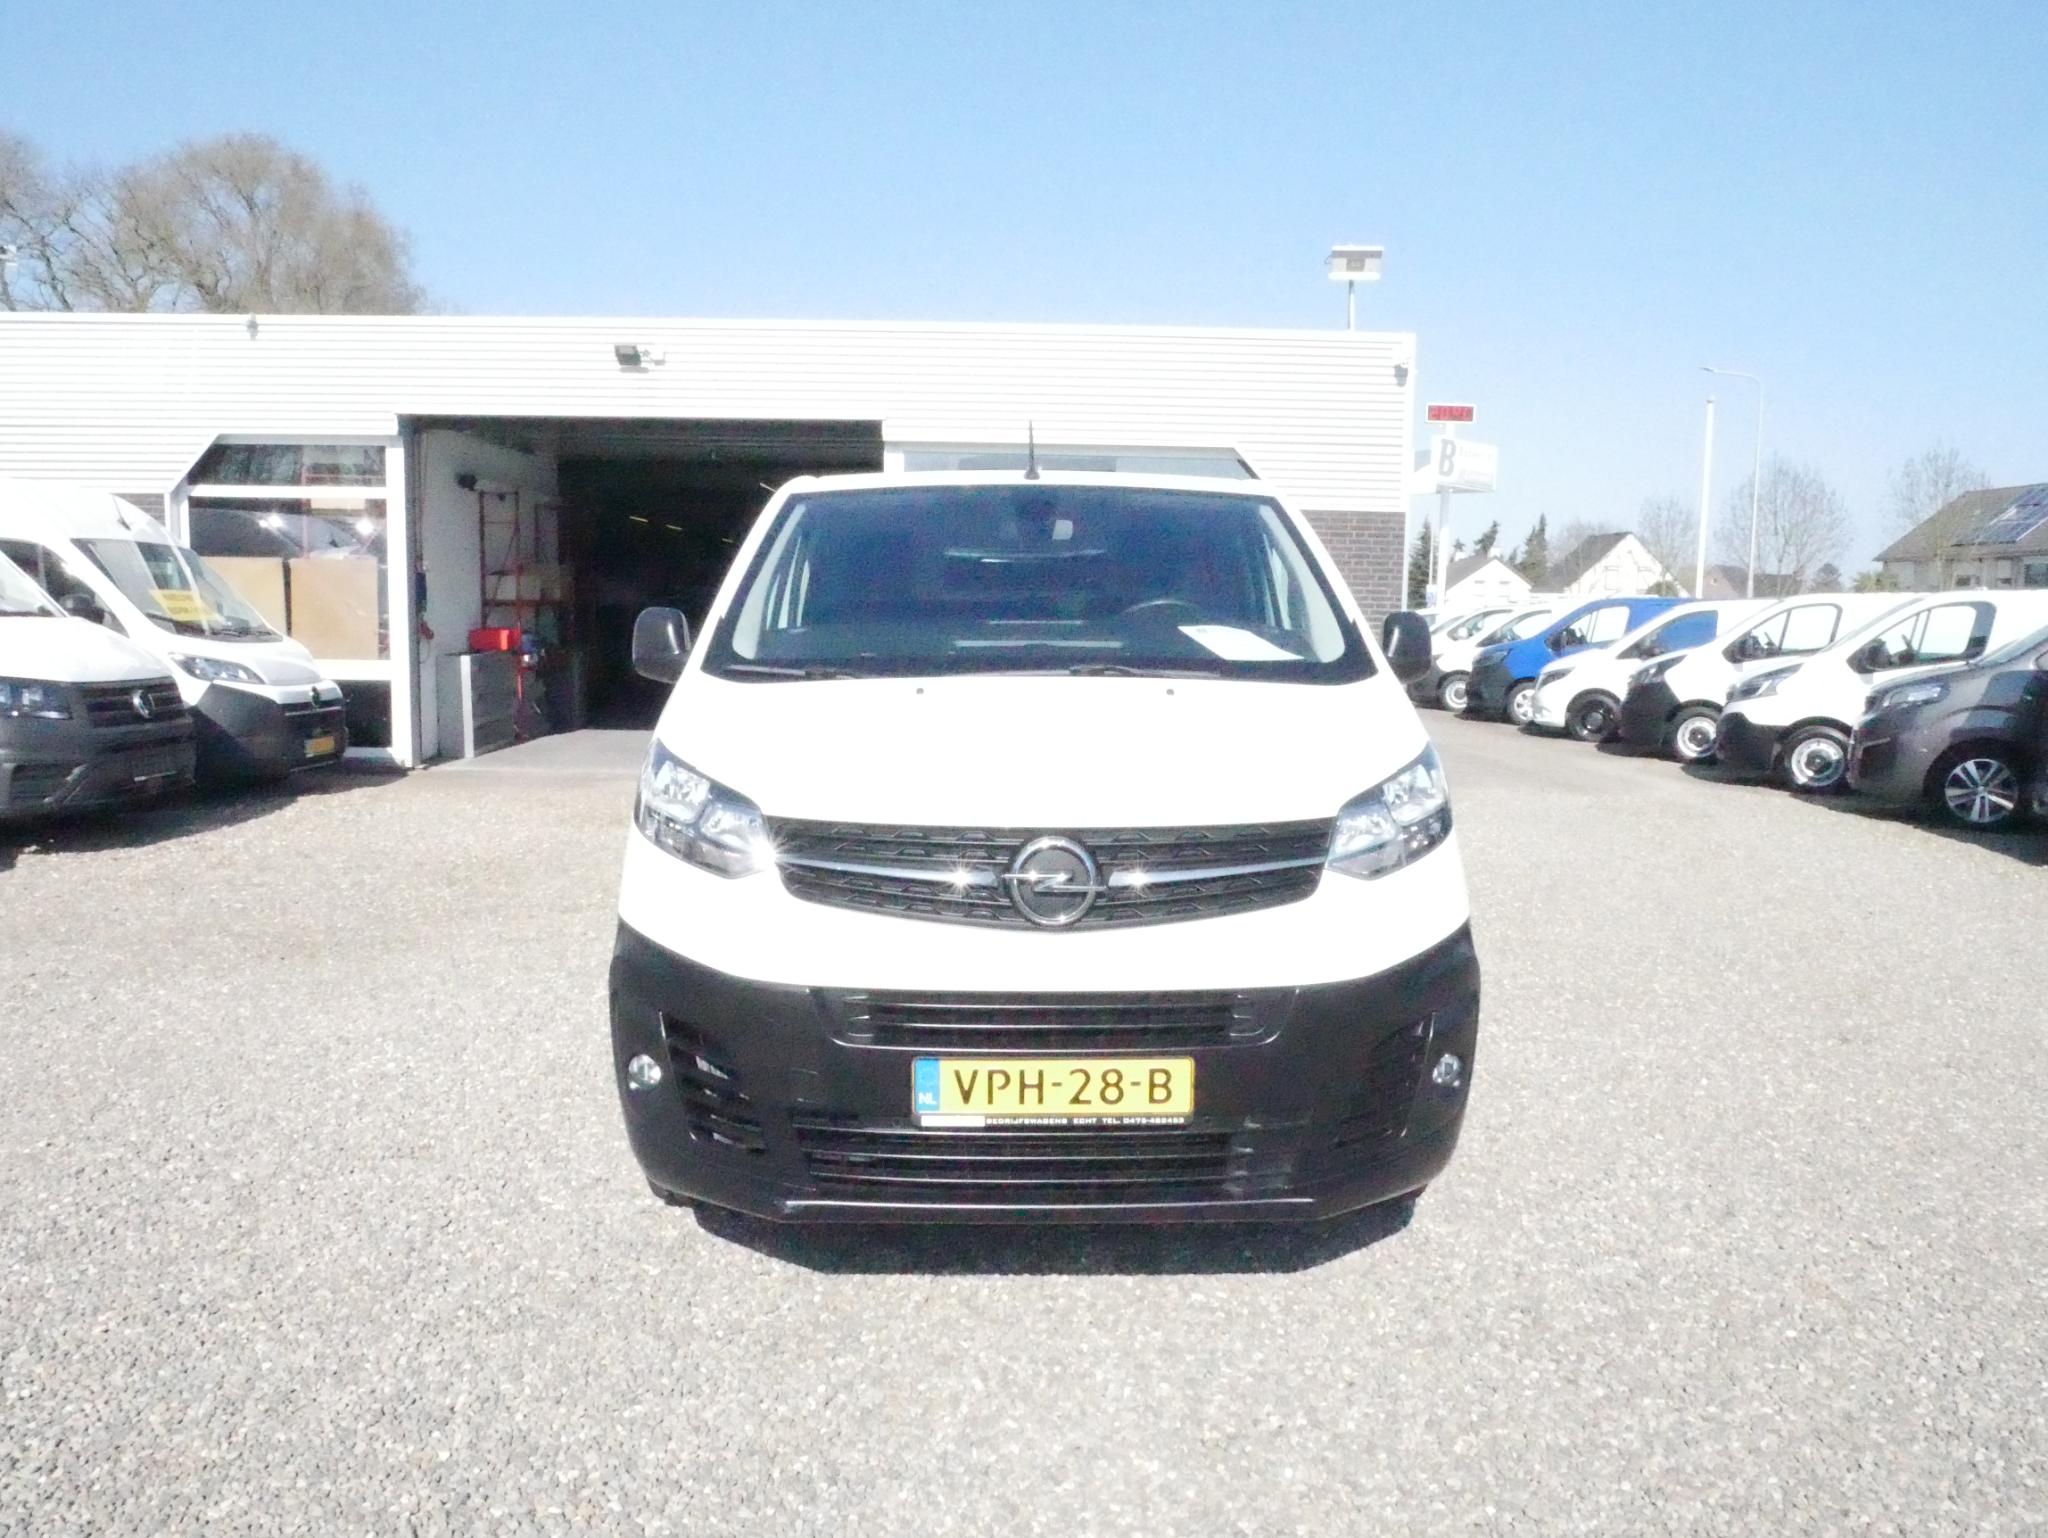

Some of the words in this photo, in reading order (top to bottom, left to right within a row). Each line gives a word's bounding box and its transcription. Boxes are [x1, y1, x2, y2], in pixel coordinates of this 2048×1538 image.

[1439, 438, 1456, 477] B
[918, 1092, 937, 1105] NL
[954, 1068, 1172, 1105] VPH-28-B
